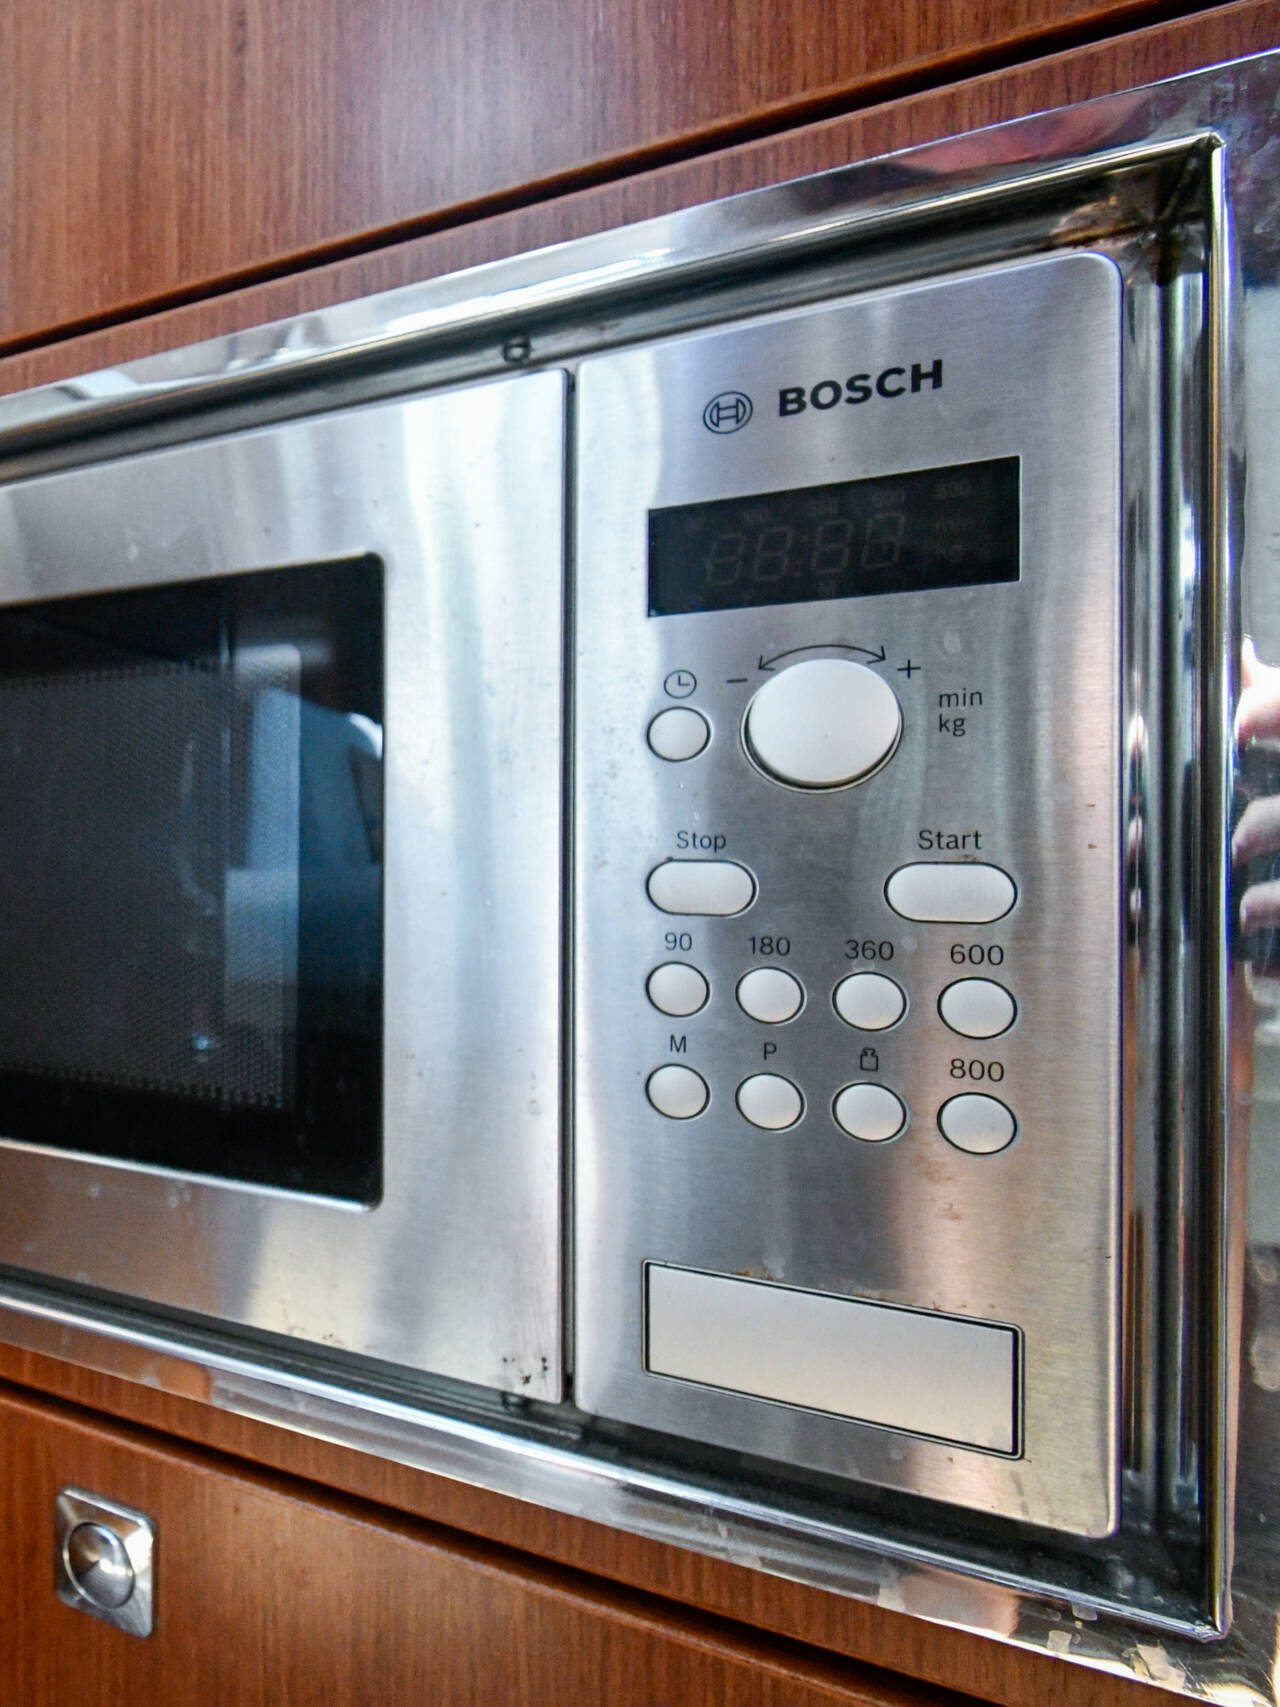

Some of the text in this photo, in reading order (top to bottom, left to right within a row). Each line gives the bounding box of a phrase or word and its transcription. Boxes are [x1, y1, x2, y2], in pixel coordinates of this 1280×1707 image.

[778, 358, 943, 418] BOSCH
[937, 687, 984, 709] min
[938, 713, 966, 737] kg
[675, 829, 729, 853] Stop
[917, 829, 982, 851] Start
[664, 932, 693, 952] 90
[748, 935, 791, 957] 180
[844, 939, 895, 962] 360
[950, 943, 1005, 966] 600
[669, 1034, 687, 1054] M
[763, 1041, 778, 1061] P
[949, 1057, 1005, 1083] 800
